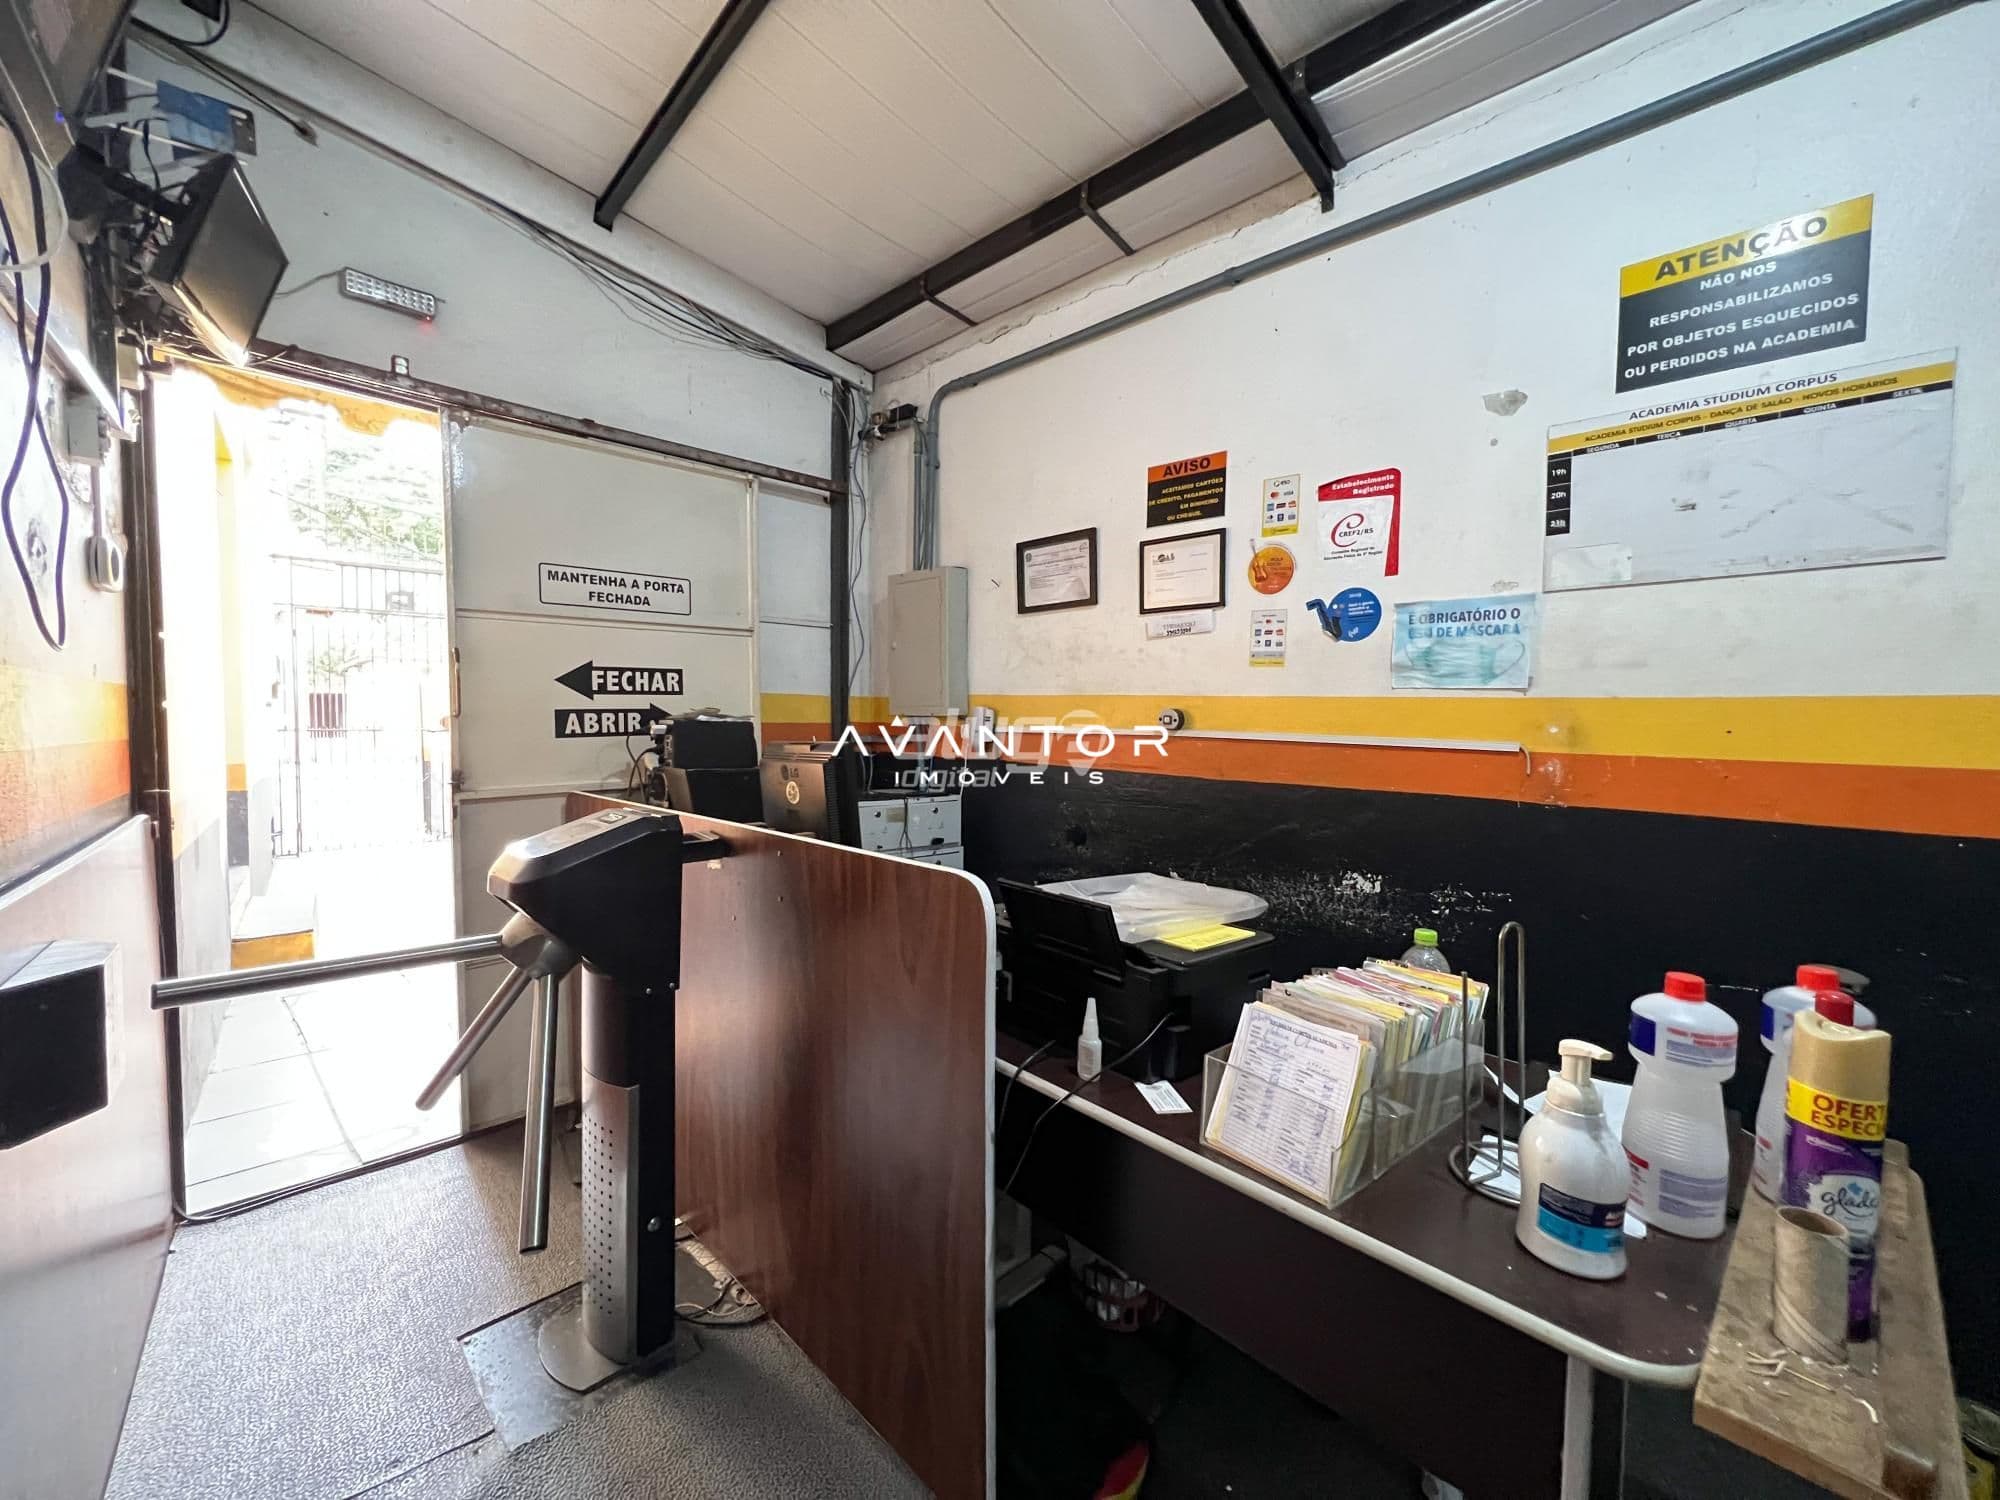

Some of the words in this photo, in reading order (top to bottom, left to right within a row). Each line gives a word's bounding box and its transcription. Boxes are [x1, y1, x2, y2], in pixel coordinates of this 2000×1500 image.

[1655, 217, 1828, 281] ATENÇÃO
[1700, 272, 1735, 291] NÃO
[1740, 261, 1777, 280] NOS
[1650, 273, 1833, 328] RESPONSABILIZAMOS
[1627, 341, 1658, 357] POR
[1662, 322, 1737, 348] OBJETOS
[1742, 293, 1859, 330] ESQUECIDOS
[1624, 365, 1646, 379] OU
[1650, 347, 1728, 373] PERDIDOS
[1733, 341, 1757, 354] NA
[1761, 318, 1856, 349] ACADEMIA
[1629, 399, 1699, 420] ACADEMIA
[1703, 386, 1771, 407] STUDIUM
[1775, 373, 1837, 393] CORPUS
[1584, 429, 1626, 442] ACADEMIA
[1628, 422, 1664, 433] STUDIUM
[1666, 415, 1701, 427] CORPUS
[1710, 406, 1743, 419] DANÇA
[1746, 402, 1758, 412] DE
[1802, 387, 1839, 401] NOVOS
[1163, 457, 1211, 478] AVISO
[1332, 474, 1394, 490] Estabelecimento
[1352, 483, 1394, 496] Registrado
[547, 569, 627, 588] MANTENHA
[631, 579, 640, 589] A
[644, 580, 685, 594] PORTA
[588, 591, 651, 606] FECHADA
[1511, 607, 1520, 619] O
[1437, 627, 1452, 638] DE
[591, 670, 681, 692] FECHAR
[564, 712, 641, 734] ABRIR
